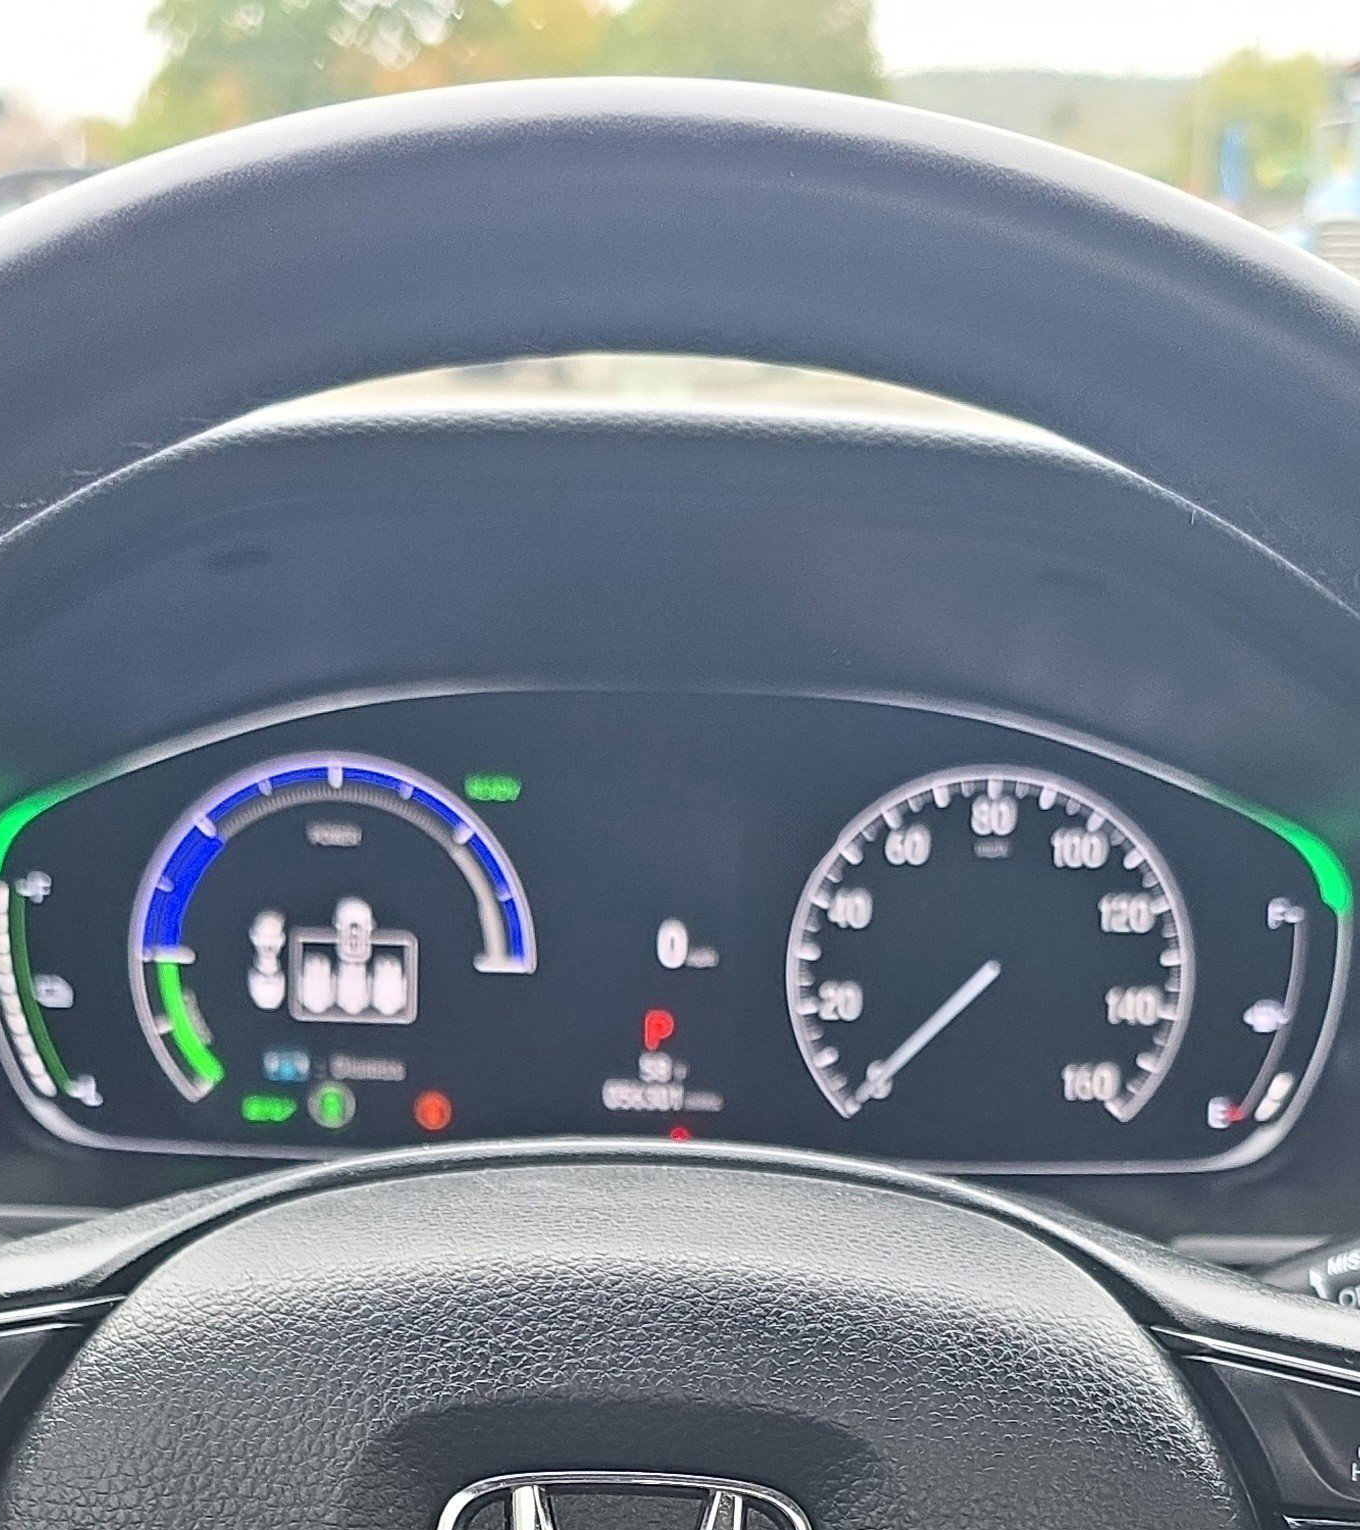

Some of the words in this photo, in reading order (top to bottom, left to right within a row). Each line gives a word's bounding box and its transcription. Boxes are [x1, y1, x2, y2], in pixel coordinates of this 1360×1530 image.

[971, 797, 1017, 835] 80
[885, 824, 931, 865] 60
[1051, 829, 1108, 868] 100
[826, 888, 873, 929] 40
[1098, 892, 1156, 933] 120
[657, 917, 689, 969] 0
[817, 981, 863, 1021] 20
[1106, 986, 1162, 1026] 140
[644, 1009, 674, 1051] P
[1063, 1062, 1120, 1101] 160
